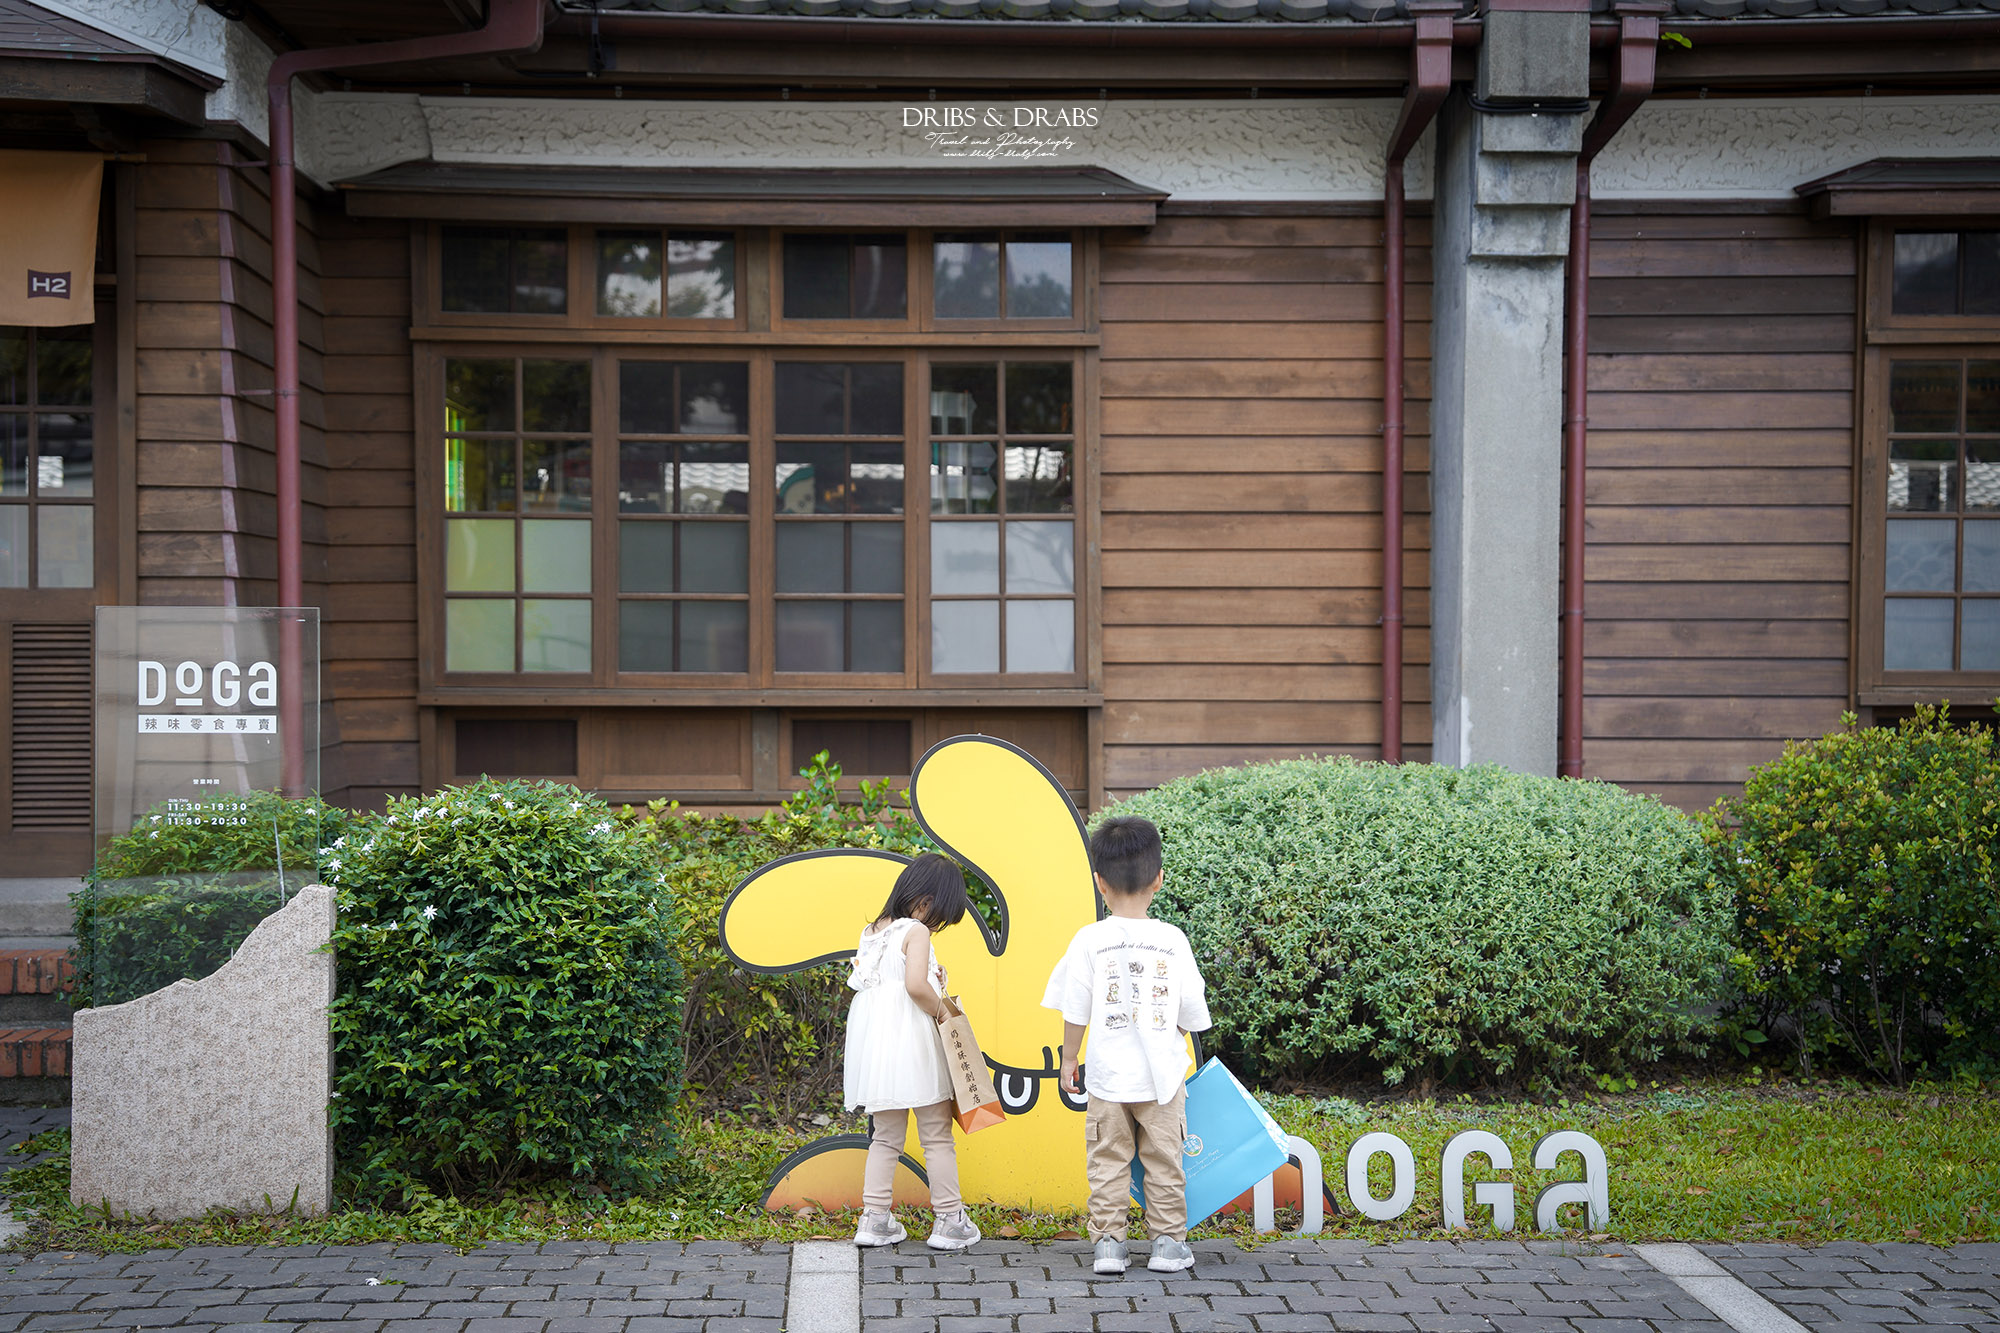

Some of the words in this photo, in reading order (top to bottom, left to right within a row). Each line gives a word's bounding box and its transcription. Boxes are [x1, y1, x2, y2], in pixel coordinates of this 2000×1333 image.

[32, 277, 67, 293] H2
[144, 718, 271, 731] 辣味零食專賣
